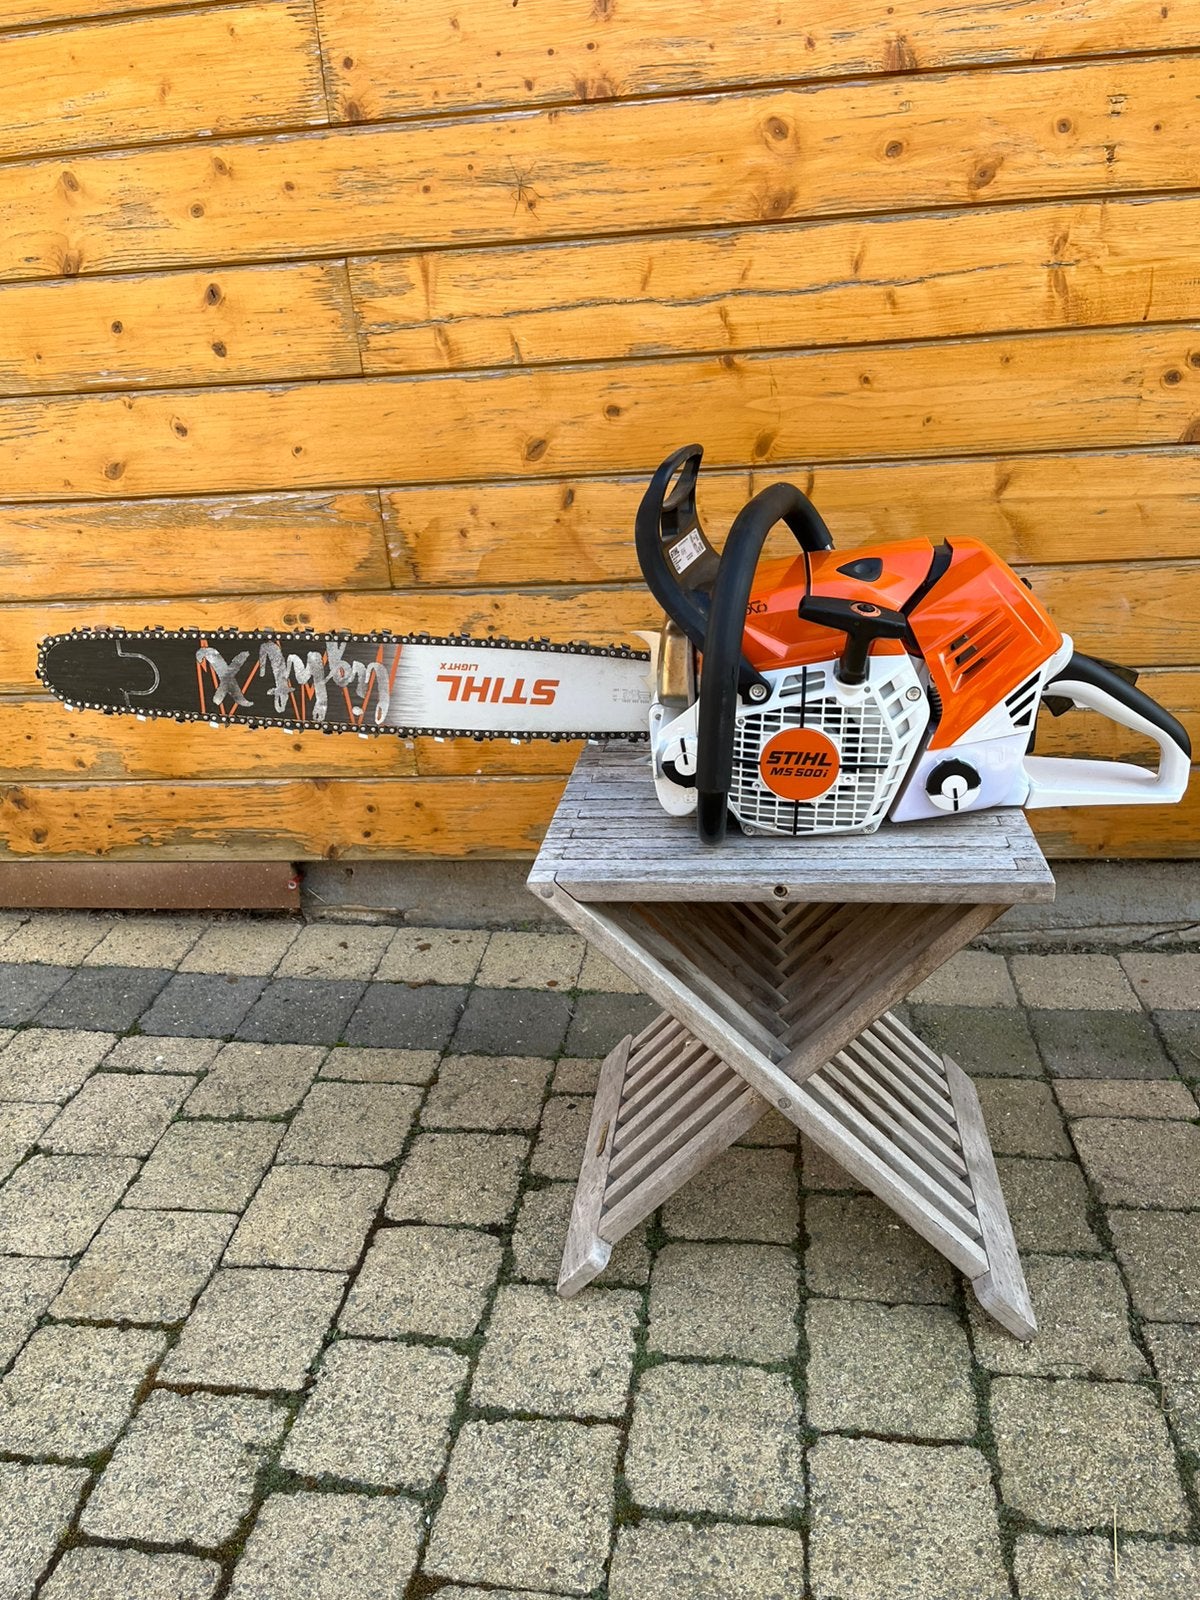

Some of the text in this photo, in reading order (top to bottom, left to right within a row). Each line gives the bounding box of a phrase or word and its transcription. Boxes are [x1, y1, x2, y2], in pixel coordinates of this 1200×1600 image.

[436, 675, 560, 705] STIHL
[766, 751, 832, 766] STIHL
[770, 767, 829, 778] MS 500i
